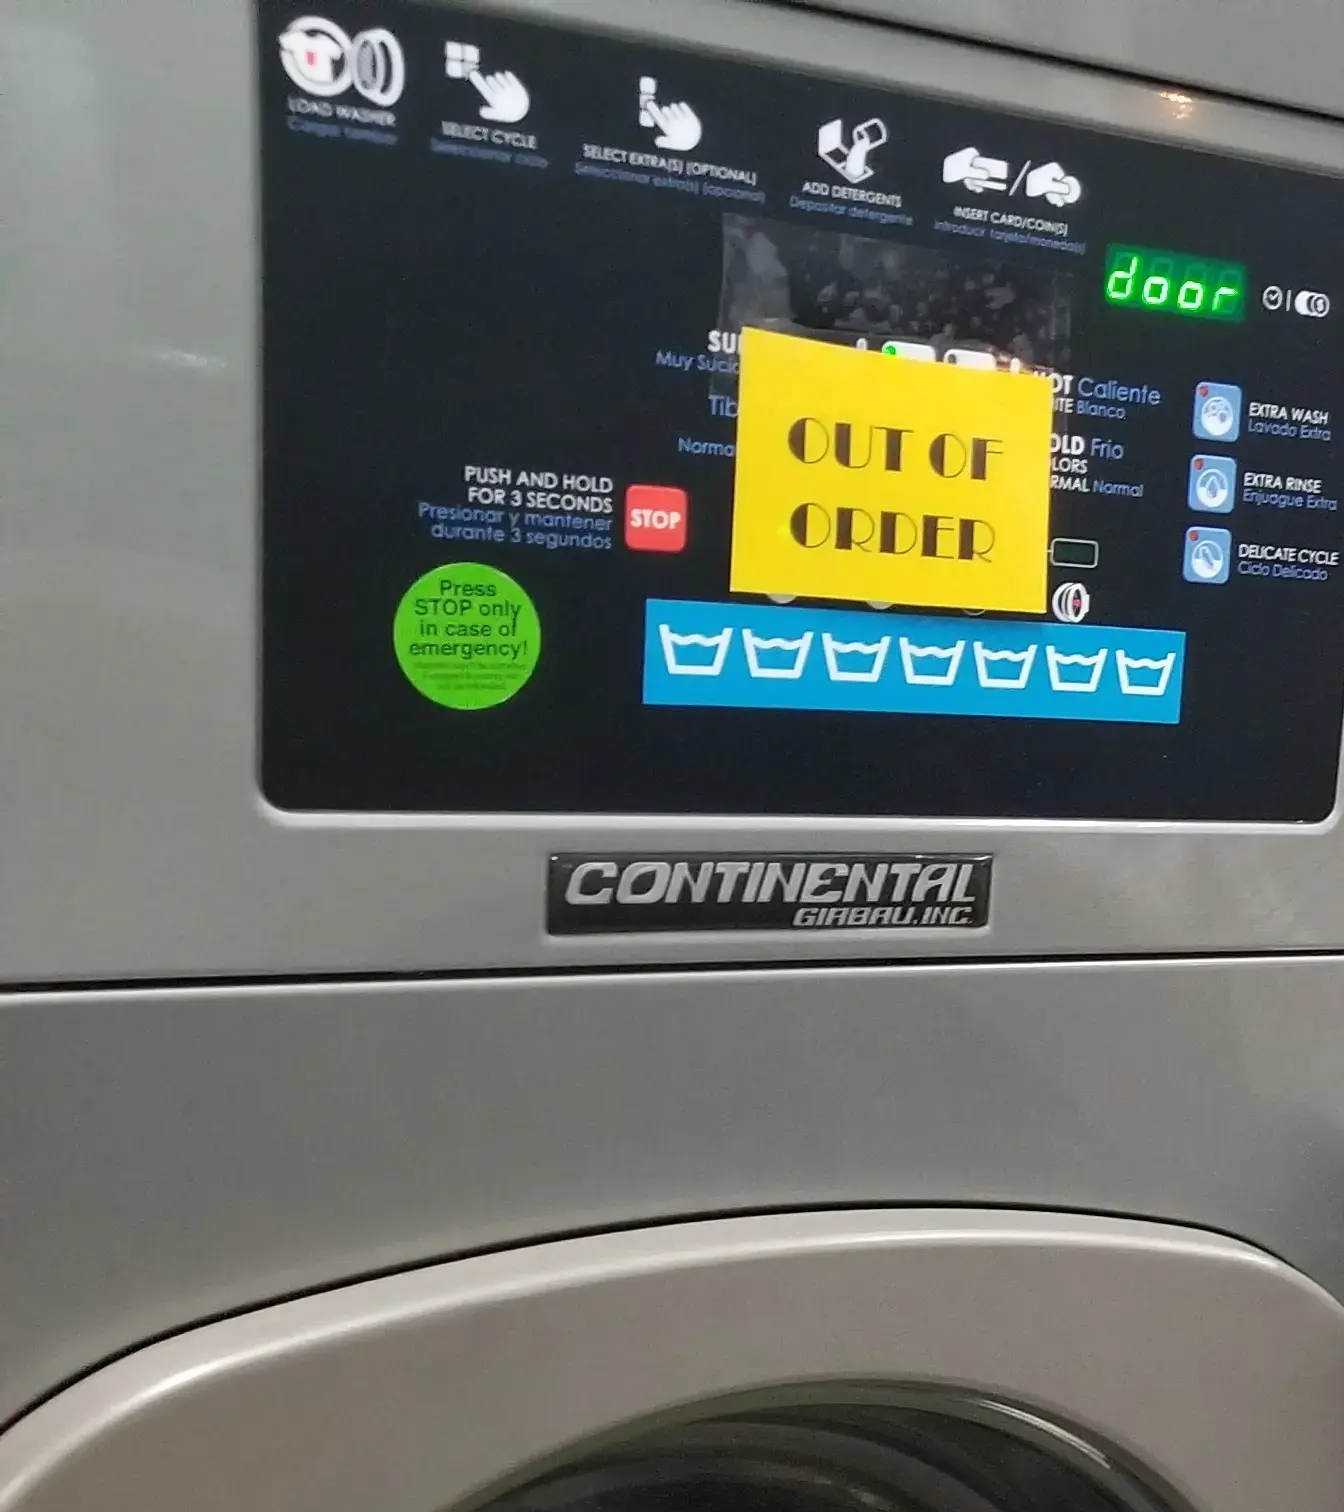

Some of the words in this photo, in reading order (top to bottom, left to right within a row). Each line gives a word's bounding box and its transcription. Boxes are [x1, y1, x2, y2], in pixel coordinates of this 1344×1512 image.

[441, 120, 488, 142] SELECT
[491, 130, 537, 150] CYCLE
[583, 143, 627, 163] SELECT
[802, 181, 829, 196] ADD
[953, 206, 988, 221] INSERT
[1107, 256, 1238, 311] door
[655, 350, 693, 371] Muy
[1046, 371, 1075, 395] OT
[1078, 377, 1161, 405] Caliente
[708, 394, 738, 418] Tib
[1248, 402, 1288, 421] EXTRA
[1291, 407, 1329, 425] WASH
[1248, 418, 1297, 437] Lavado
[1299, 425, 1332, 441] Extra
[677, 437, 736, 458] Norma
[786, 415, 915, 473] OUT
[928, 432, 1004, 482] OF
[1050, 433, 1085, 455] OLD
[1051, 457, 1088, 475] LORS
[464, 465, 511, 486] PUSH
[516, 471, 558, 489] AND
[562, 475, 613, 494] HOLD
[1050, 474, 1090, 492] RMAL
[1092, 480, 1144, 498] Normal
[1243, 472, 1283, 490] EXTRA
[1285, 476, 1322, 494] RINSE
[467, 486, 505, 505] FOR
[510, 490, 522, 508] 3
[526, 491, 613, 514] SECONDS
[1243, 488, 1304, 509] Enjuague
[1306, 494, 1338, 511] Extra
[418, 502, 505, 525] Presionar
[508, 511, 521, 527] y
[524, 511, 613, 532] mantener
[630, 508, 681, 530] STOP
[430, 521, 505, 543] durante
[510, 527, 522, 545] 3
[526, 530, 612, 550] segundos
[788, 501, 997, 564] ORDER
[1238, 544, 1297, 562] DELICATE
[1298, 549, 1340, 566] CYCLE
[1237, 560, 1270, 577] Ciclo
[1272, 563, 1328, 581] Delicado
[439, 579, 498, 598] Press
[414, 598, 472, 617] STOP
[479, 599, 522, 622] only
[420, 620, 438, 638] in
[445, 622, 492, 638] case
[498, 618, 518, 638] of
[409, 640, 528, 661] emergency!
[564, 860, 977, 906] CONTINENTAL
